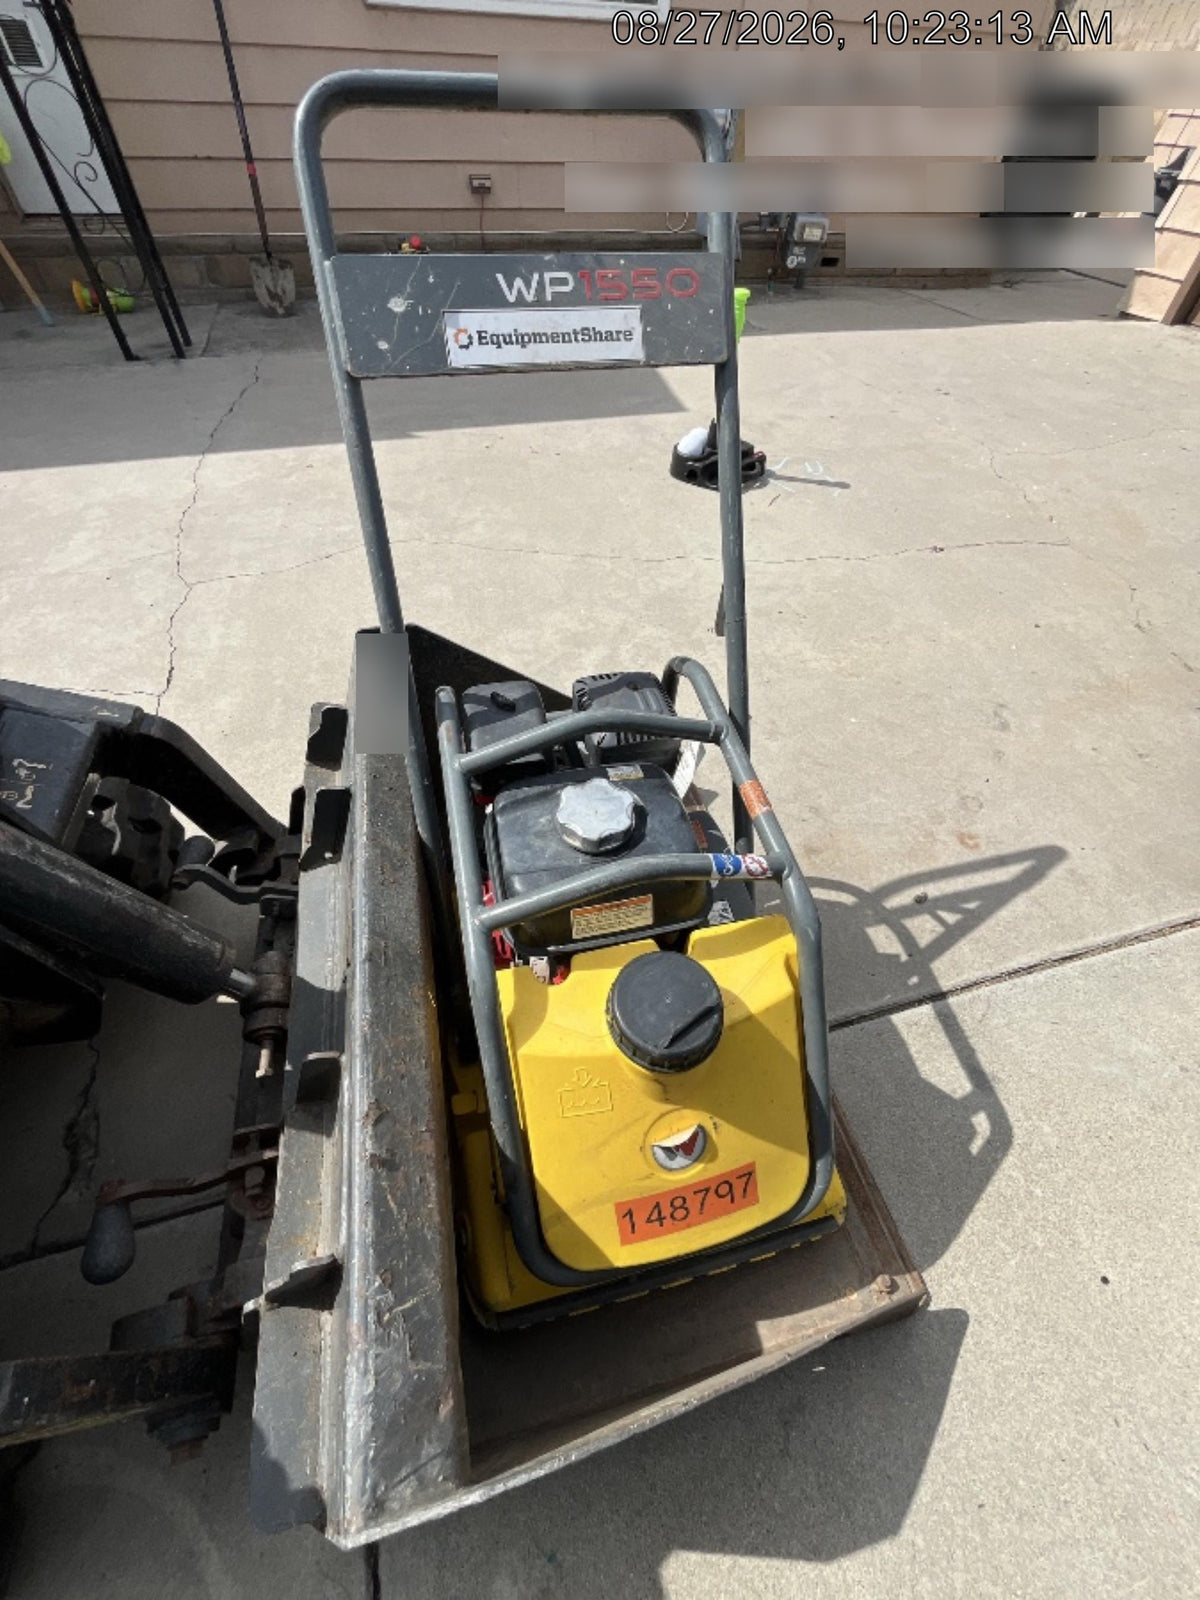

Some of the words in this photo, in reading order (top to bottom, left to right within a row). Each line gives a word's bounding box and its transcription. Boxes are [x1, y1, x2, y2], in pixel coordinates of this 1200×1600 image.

[495, 267, 702, 304] WP1550
[476, 326, 634, 349] EquipmentShare
[622, 1172, 754, 1234] 148797
